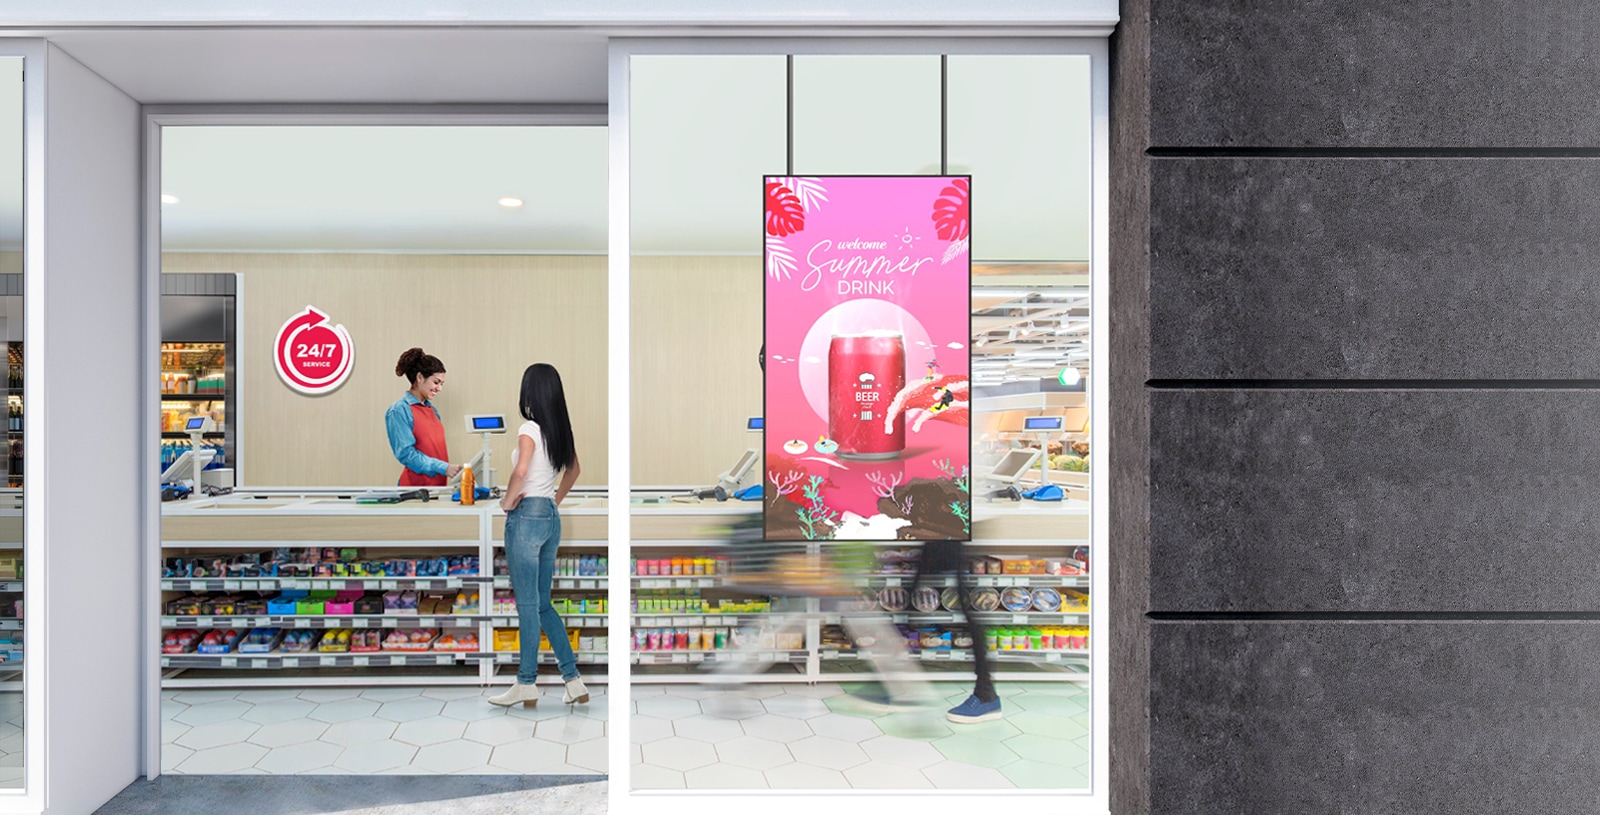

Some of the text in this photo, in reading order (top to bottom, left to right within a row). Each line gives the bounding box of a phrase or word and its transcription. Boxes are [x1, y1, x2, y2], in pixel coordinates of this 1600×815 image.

[837, 237, 887, 250] welcome
[801, 239, 934, 292] Summer
[838, 280, 895, 295] DRINK
[296, 343, 337, 358] 24/7
[855, 391, 880, 402] BEER
